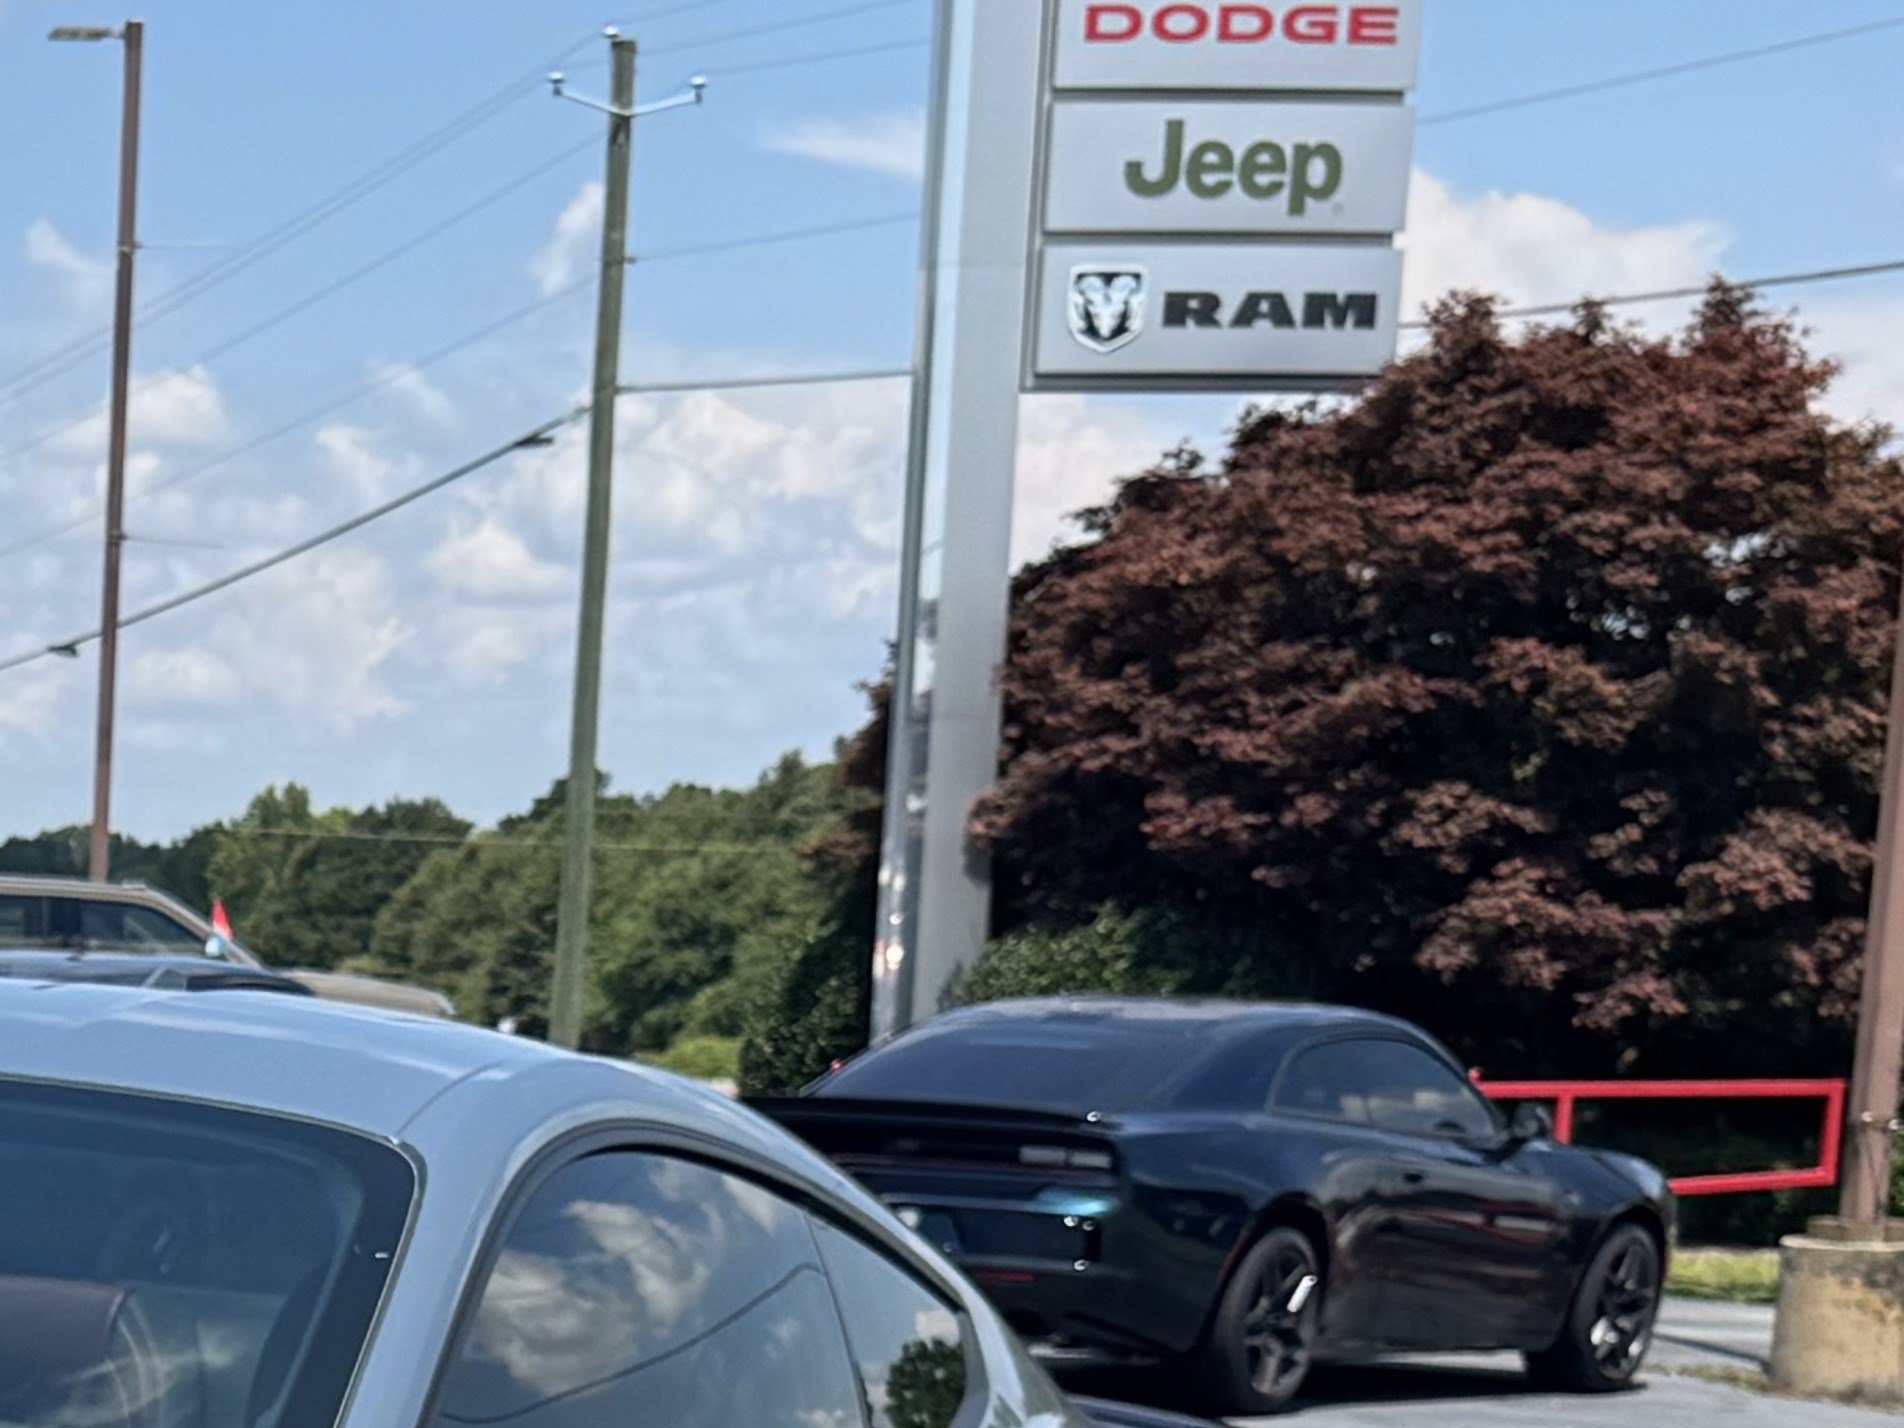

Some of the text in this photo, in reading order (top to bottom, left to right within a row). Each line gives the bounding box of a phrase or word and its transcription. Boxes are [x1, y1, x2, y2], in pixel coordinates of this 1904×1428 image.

[1084, 4, 1399, 44] DODGE
[1124, 119, 1343, 216] Jeep
[1163, 291, 1377, 329] RAM
